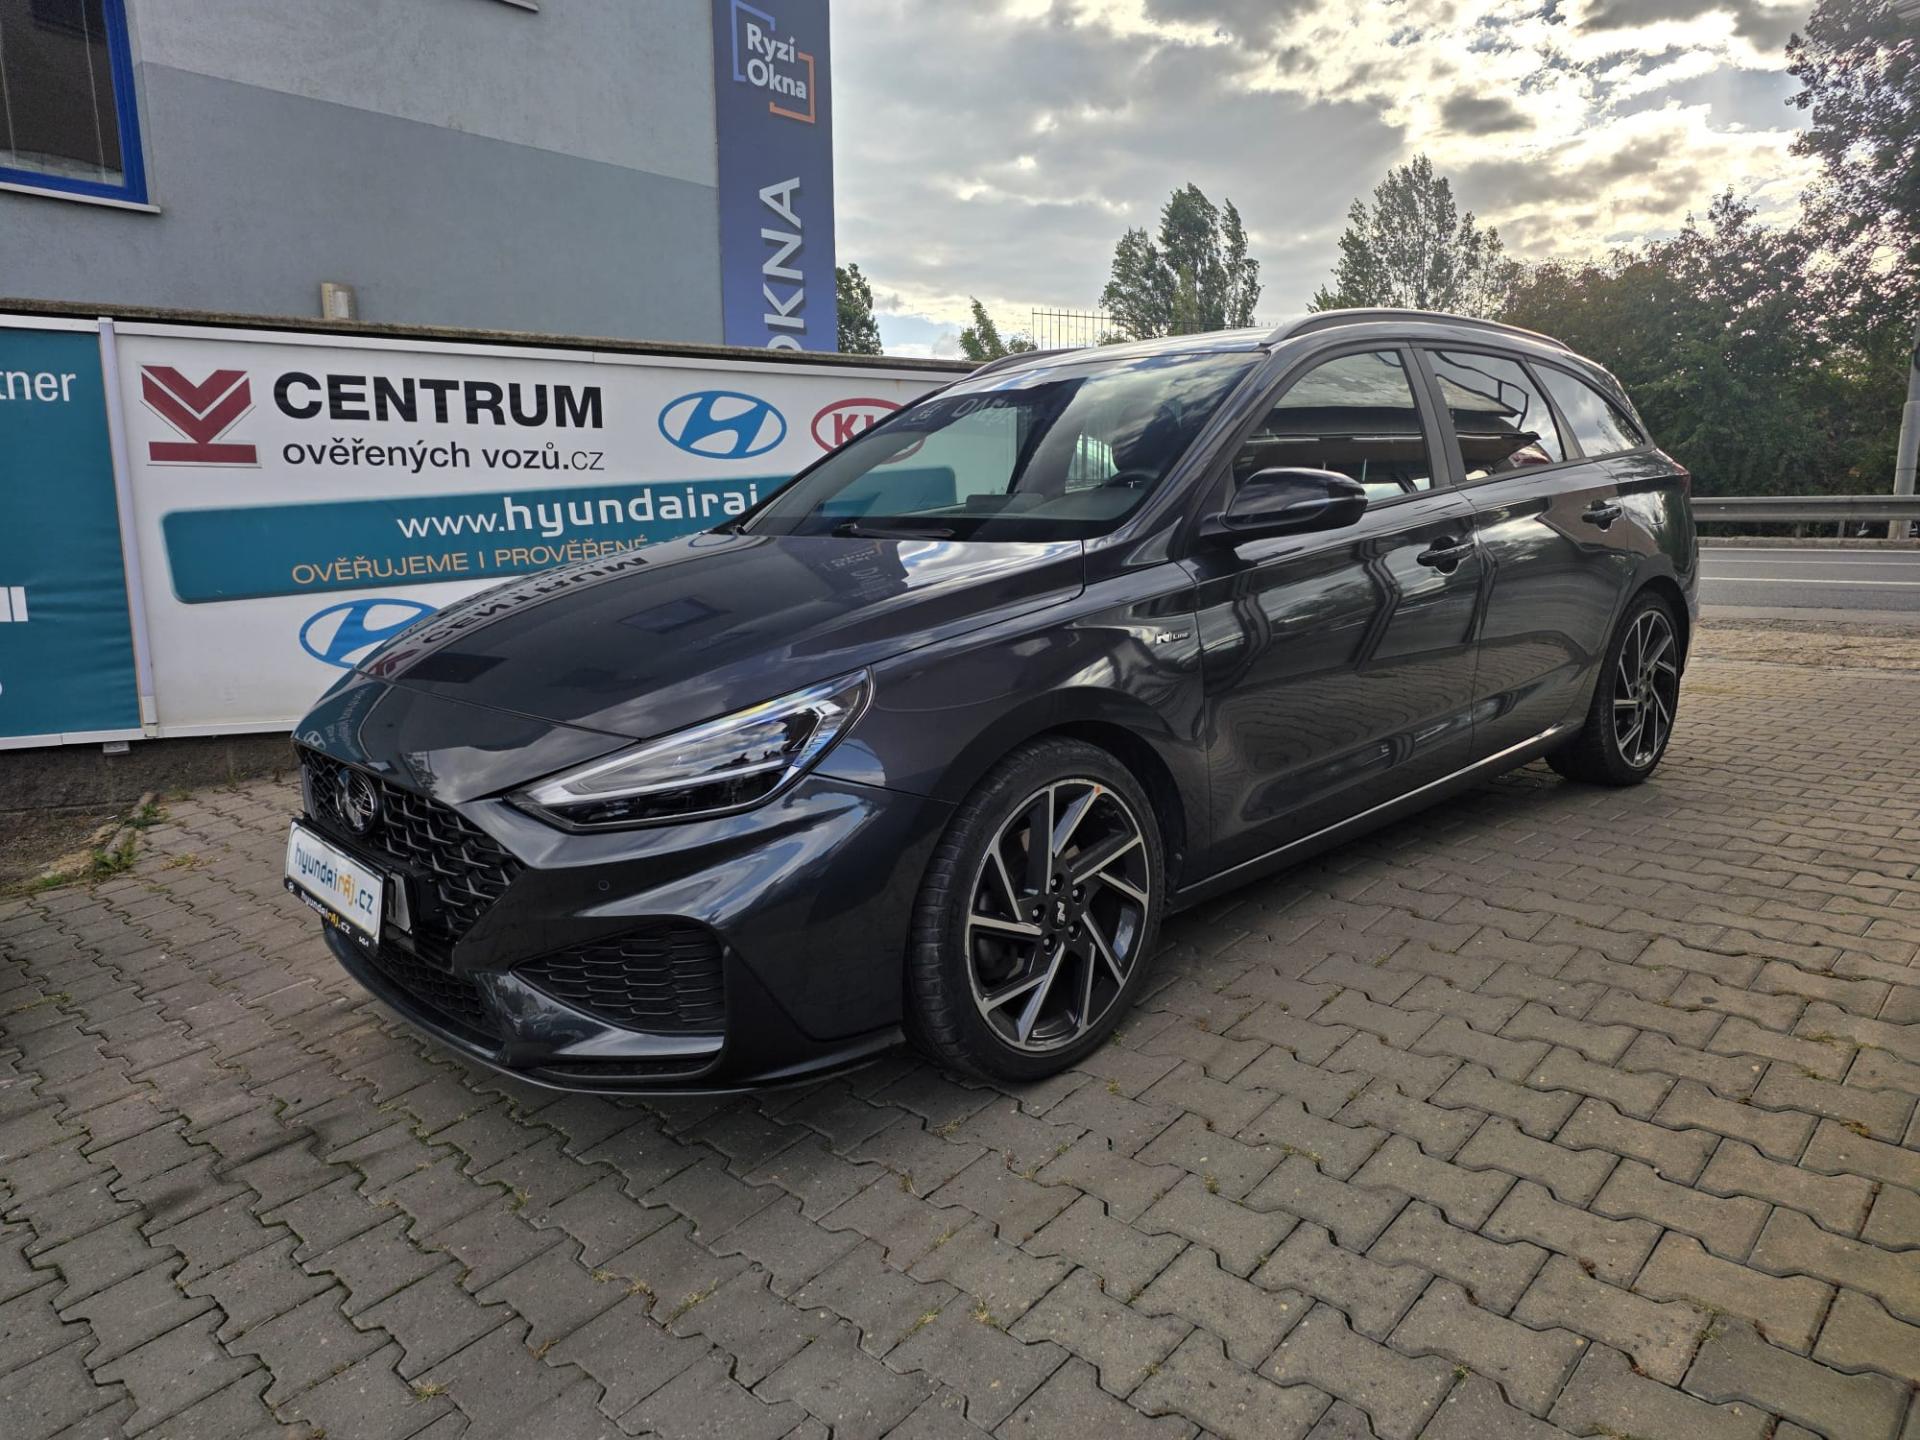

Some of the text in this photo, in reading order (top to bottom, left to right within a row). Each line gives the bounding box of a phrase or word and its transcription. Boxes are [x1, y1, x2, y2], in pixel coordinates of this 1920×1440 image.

[747, 58, 807, 100] Okna
[273, 371, 604, 429] CENTRUM
[283, 436, 605, 474] ověřených vozů.cz
[292, 551, 469, 585] OVĚŘUJEME
[479, 551, 485, 569] I
